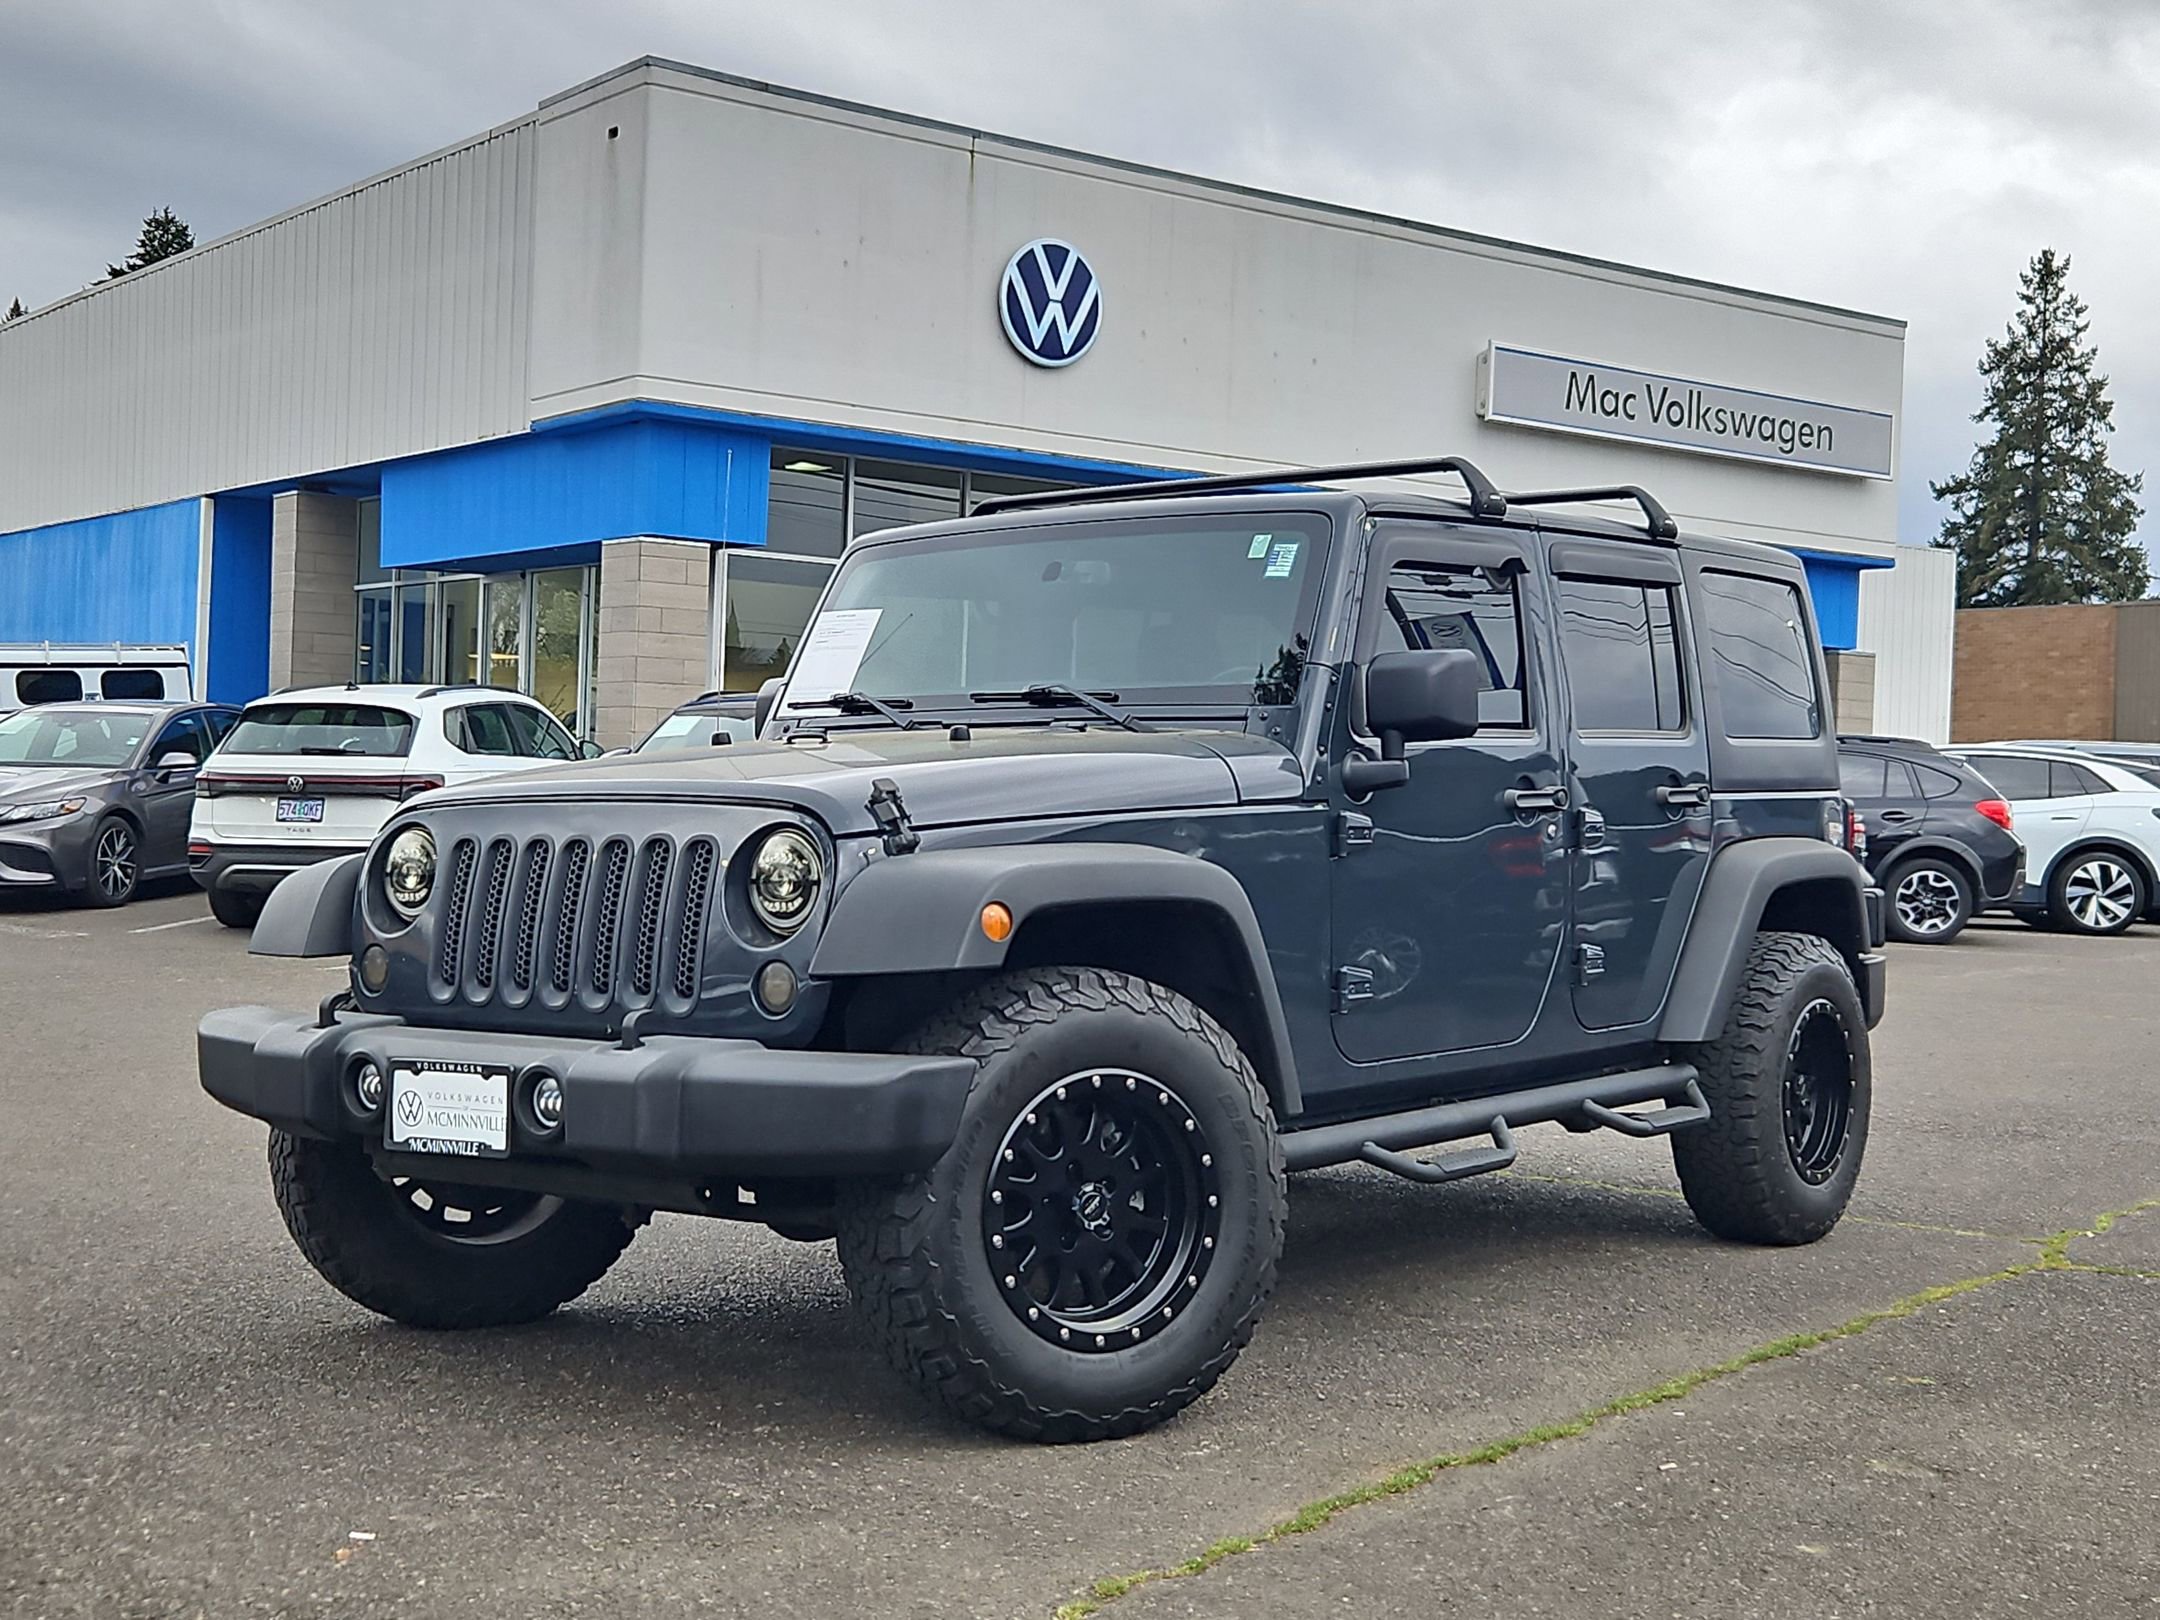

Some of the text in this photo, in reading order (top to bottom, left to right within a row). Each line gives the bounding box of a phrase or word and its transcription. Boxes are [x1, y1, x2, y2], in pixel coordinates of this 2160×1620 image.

[1565, 371, 1833, 454] Mac Volkswagen
[416, 1062, 483, 1072] VOLKSWAGEN
[427, 1091, 504, 1105] VOLKSWAGEN
[427, 1111, 504, 1132] MCMINNVILLE
[408, 1138, 480, 1156] MCMINNVILLE
